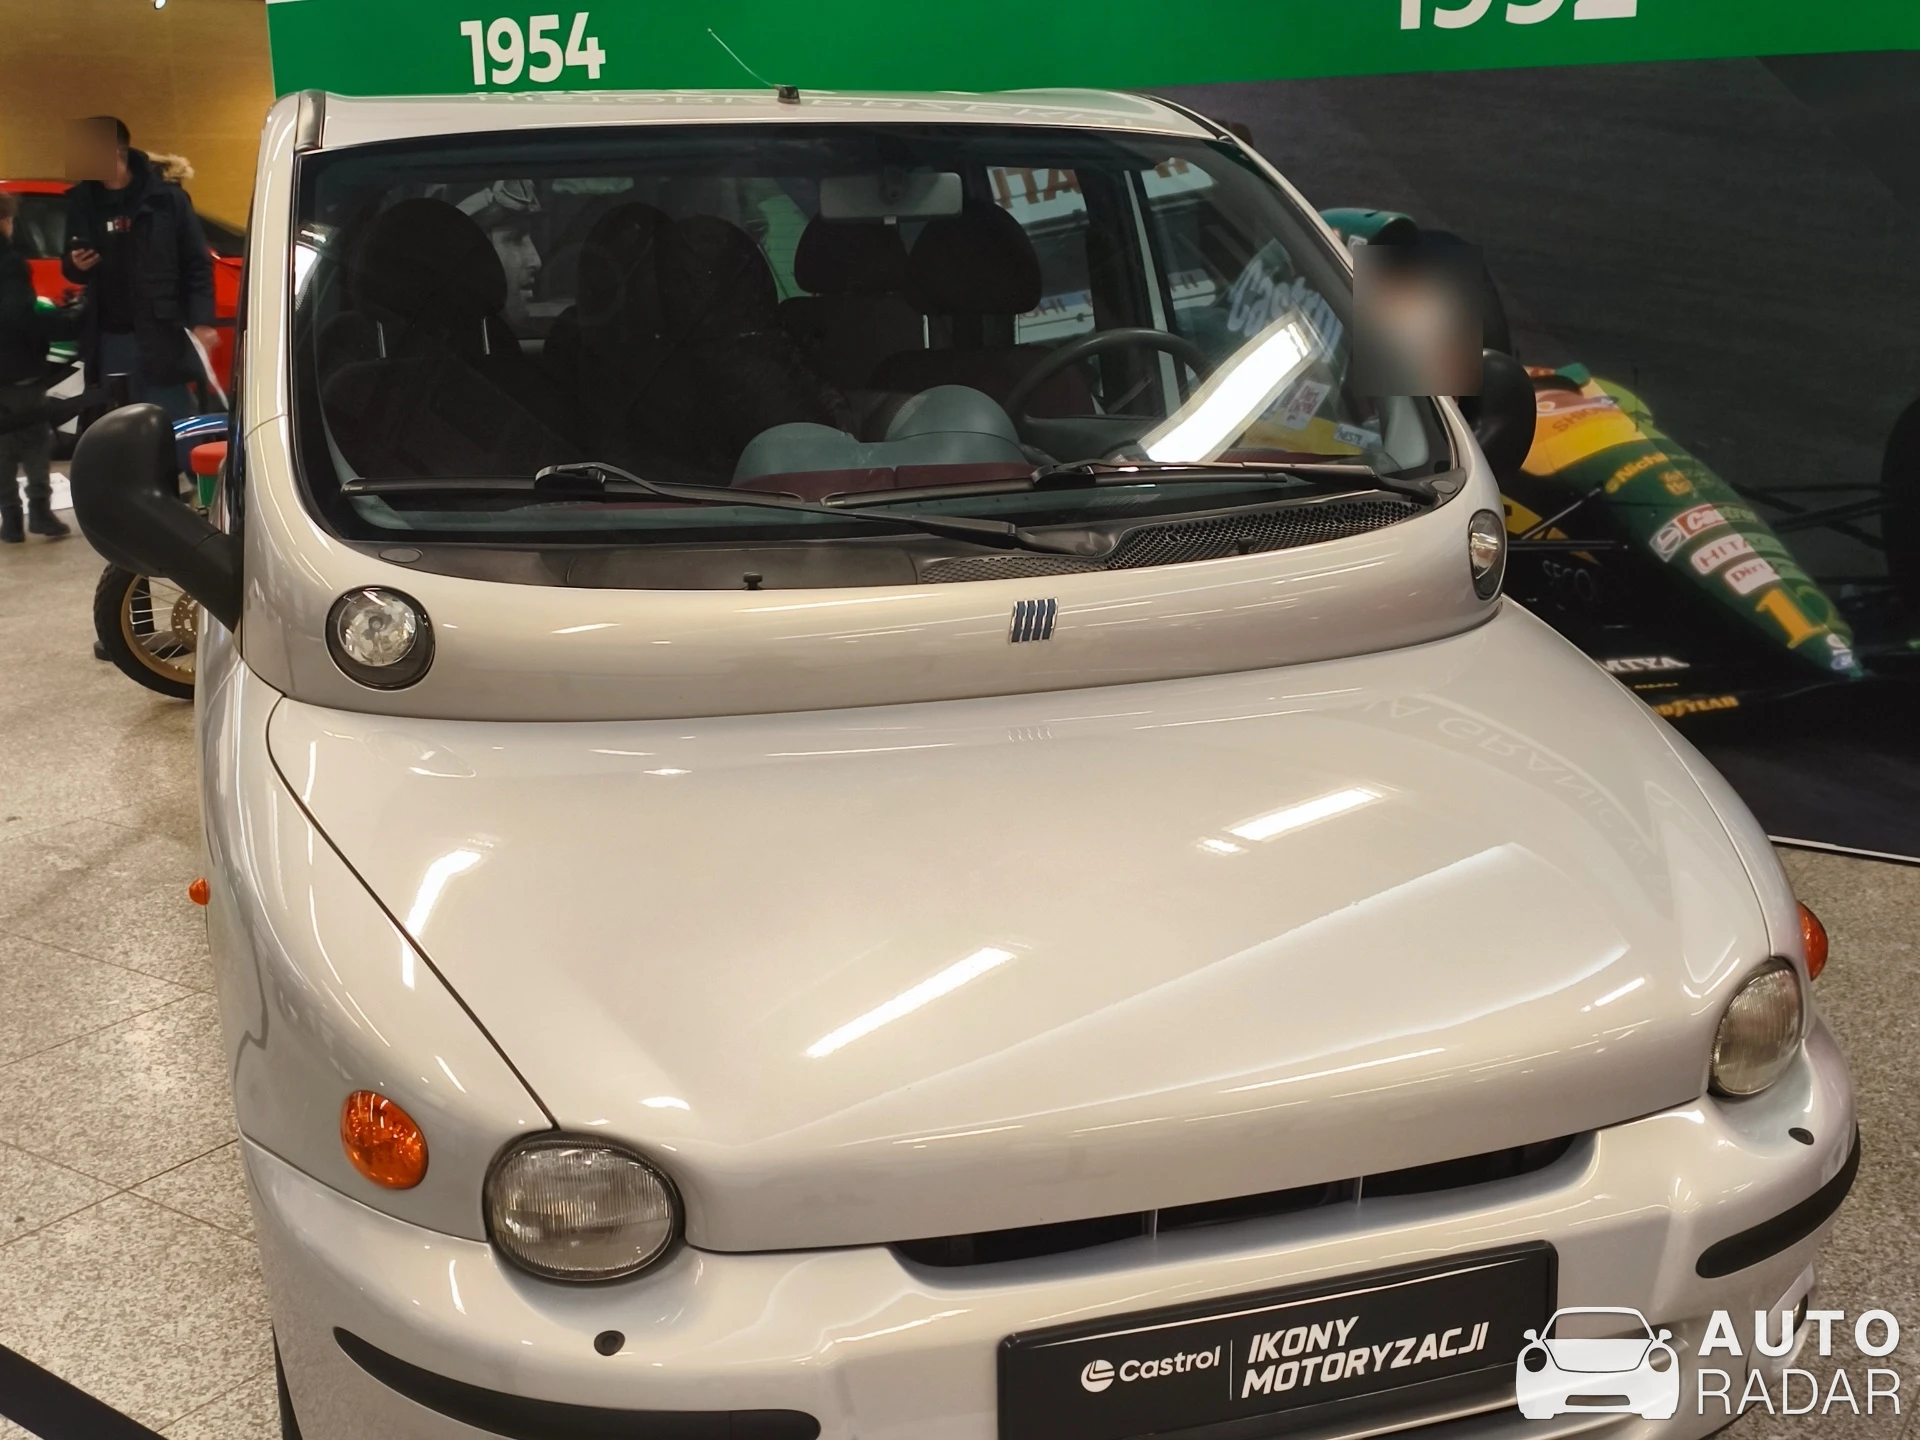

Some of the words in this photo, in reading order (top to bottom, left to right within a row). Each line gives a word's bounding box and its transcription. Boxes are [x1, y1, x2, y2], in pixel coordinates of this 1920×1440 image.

[460, 12, 606, 85] 1954
[1119, 1346, 1221, 1382] Castrol
[1247, 1315, 1359, 1364] IKONY
[1241, 1321, 1490, 1399] MOTORYZACJI
